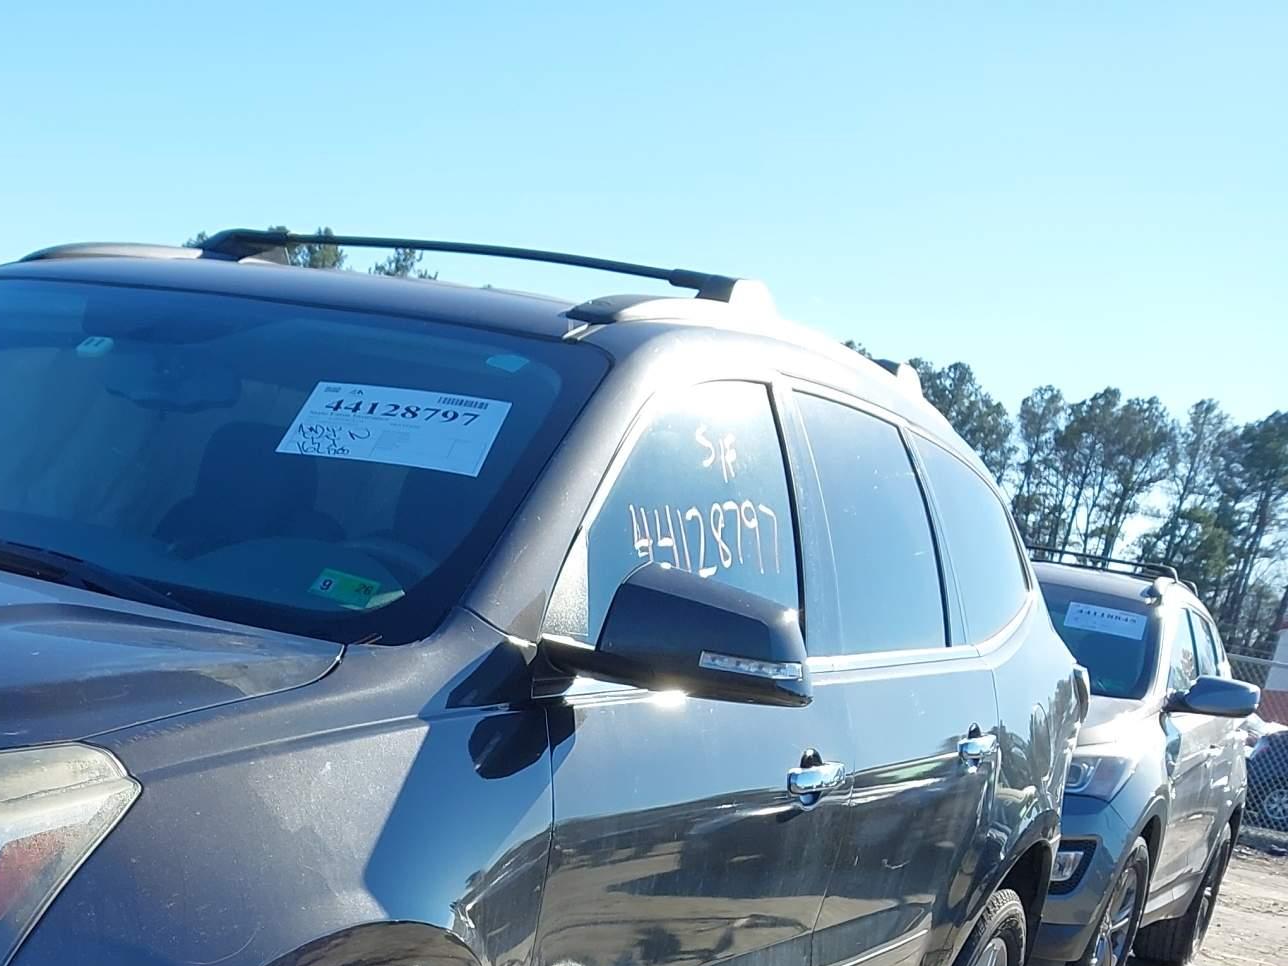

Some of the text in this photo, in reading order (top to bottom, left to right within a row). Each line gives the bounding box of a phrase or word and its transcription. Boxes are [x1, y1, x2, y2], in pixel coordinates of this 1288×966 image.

[325, 397, 480, 426] 44128797
[629, 500, 780, 578] 44128797
[320, 579, 333, 591] 9
